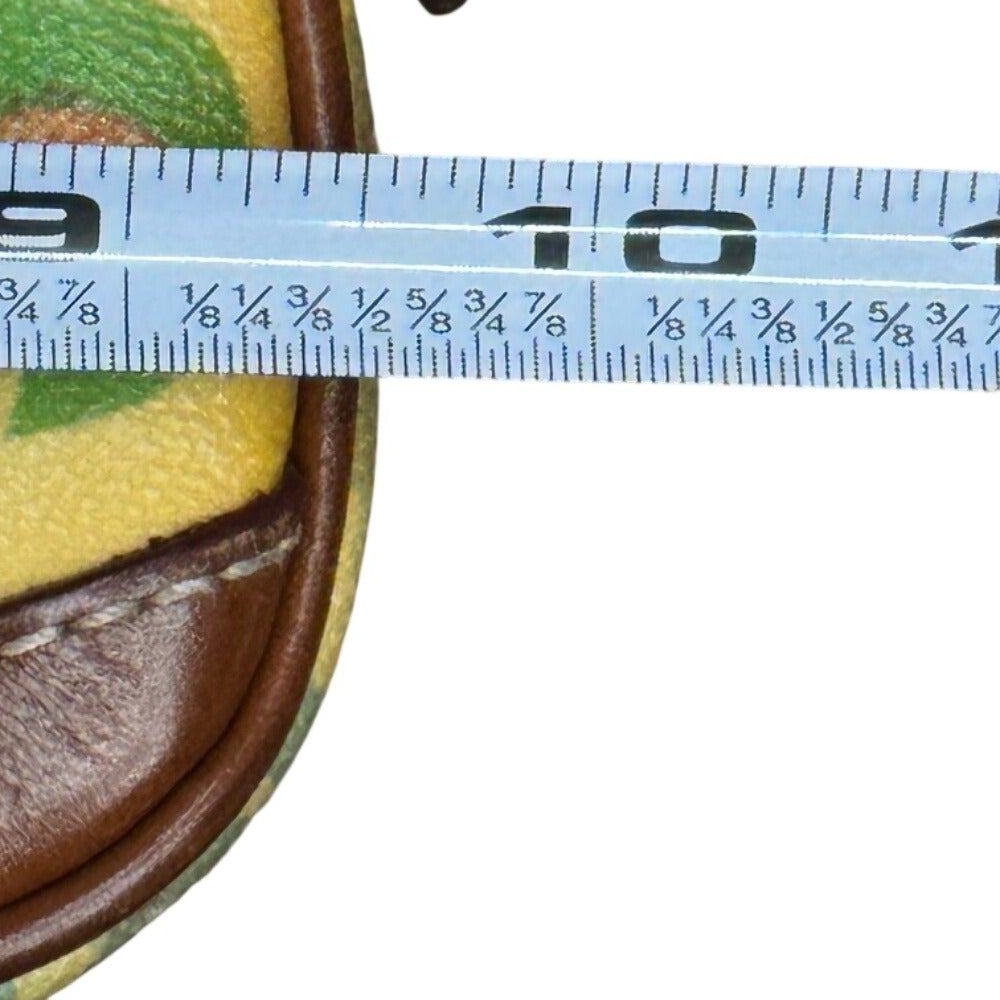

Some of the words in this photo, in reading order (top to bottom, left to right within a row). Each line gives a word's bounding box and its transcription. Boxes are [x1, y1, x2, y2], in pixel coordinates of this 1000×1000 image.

[484, 206, 757, 275] 10
[57, 278, 100, 325] 7/8
[181, 283, 221, 328] 1/8
[232, 285, 273, 329] 1/4
[287, 285, 333, 331] 3/8
[351, 288, 391, 332] 1/2
[406, 289, 452, 333] 5/8
[464, 289, 507, 333] 3/4
[525, 292, 567, 336] 7/8
[647, 296, 685, 341] 1/8
[698, 297, 737, 341] 1/4
[751, 298, 796, 343] 3/8
[816, 301, 855, 345] 1/2
[868, 302, 914, 347] 5/8
[926, 302, 969, 346] 3/4
